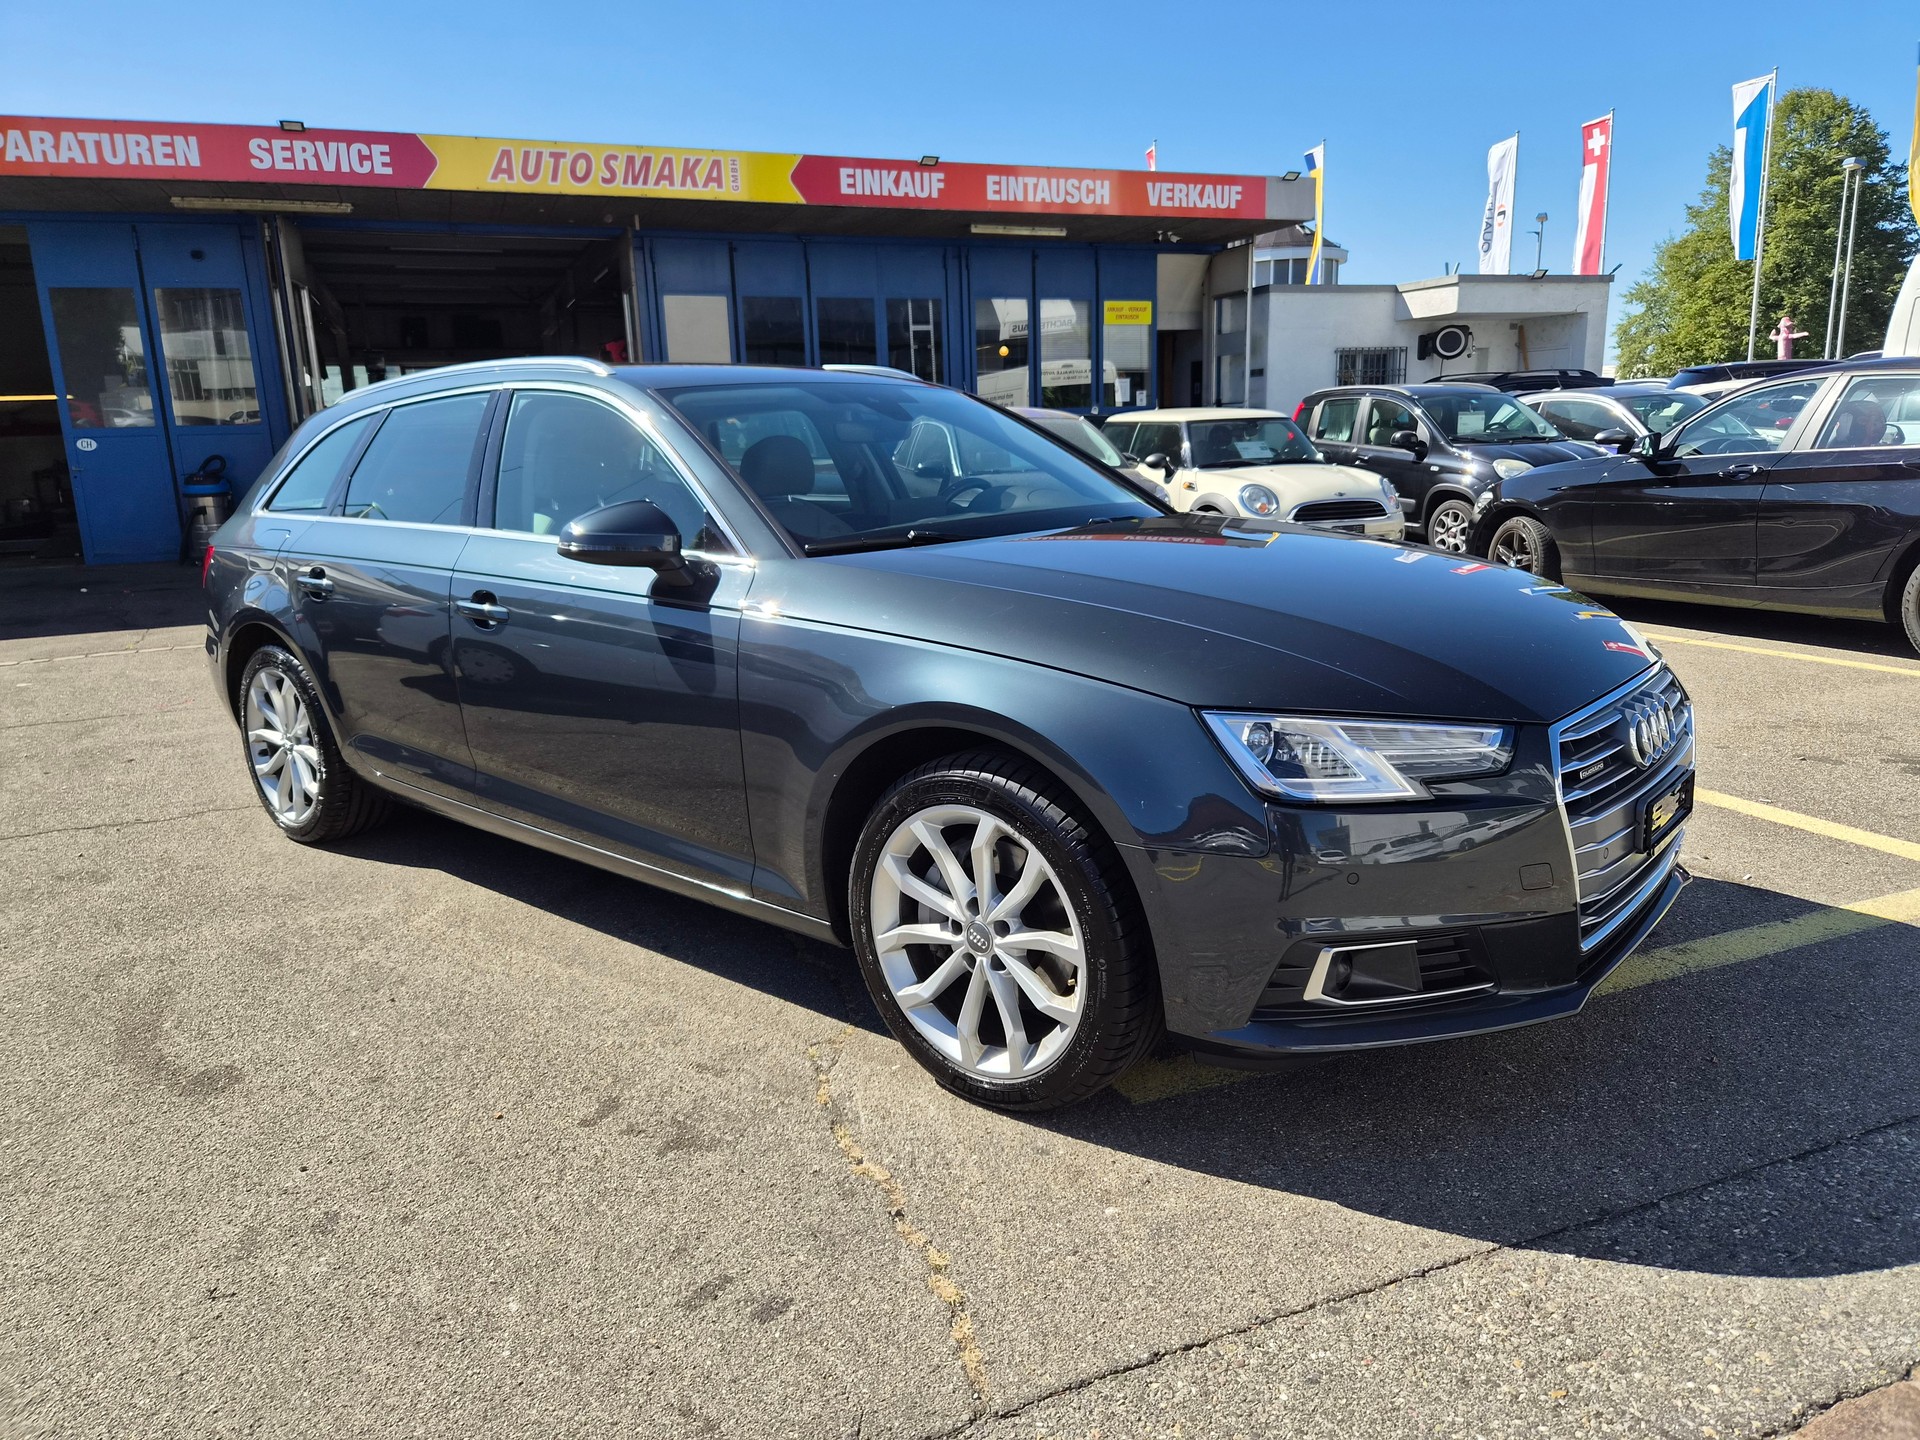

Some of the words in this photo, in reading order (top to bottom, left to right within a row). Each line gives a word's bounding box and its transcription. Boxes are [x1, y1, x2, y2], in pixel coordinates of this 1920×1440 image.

[0, 129, 200, 167] ARATUREN
[248, 138, 393, 175] SERVICE
[489, 147, 595, 186] AUTO
[600, 153, 725, 192] SMAKA
[729, 158, 740, 192] GMBH
[840, 167, 945, 199] EINKAUF
[986, 175, 1110, 205] EINTAUSCH
[1147, 182, 1242, 210] VERKAUF
[80, 439, 92, 449] CH
